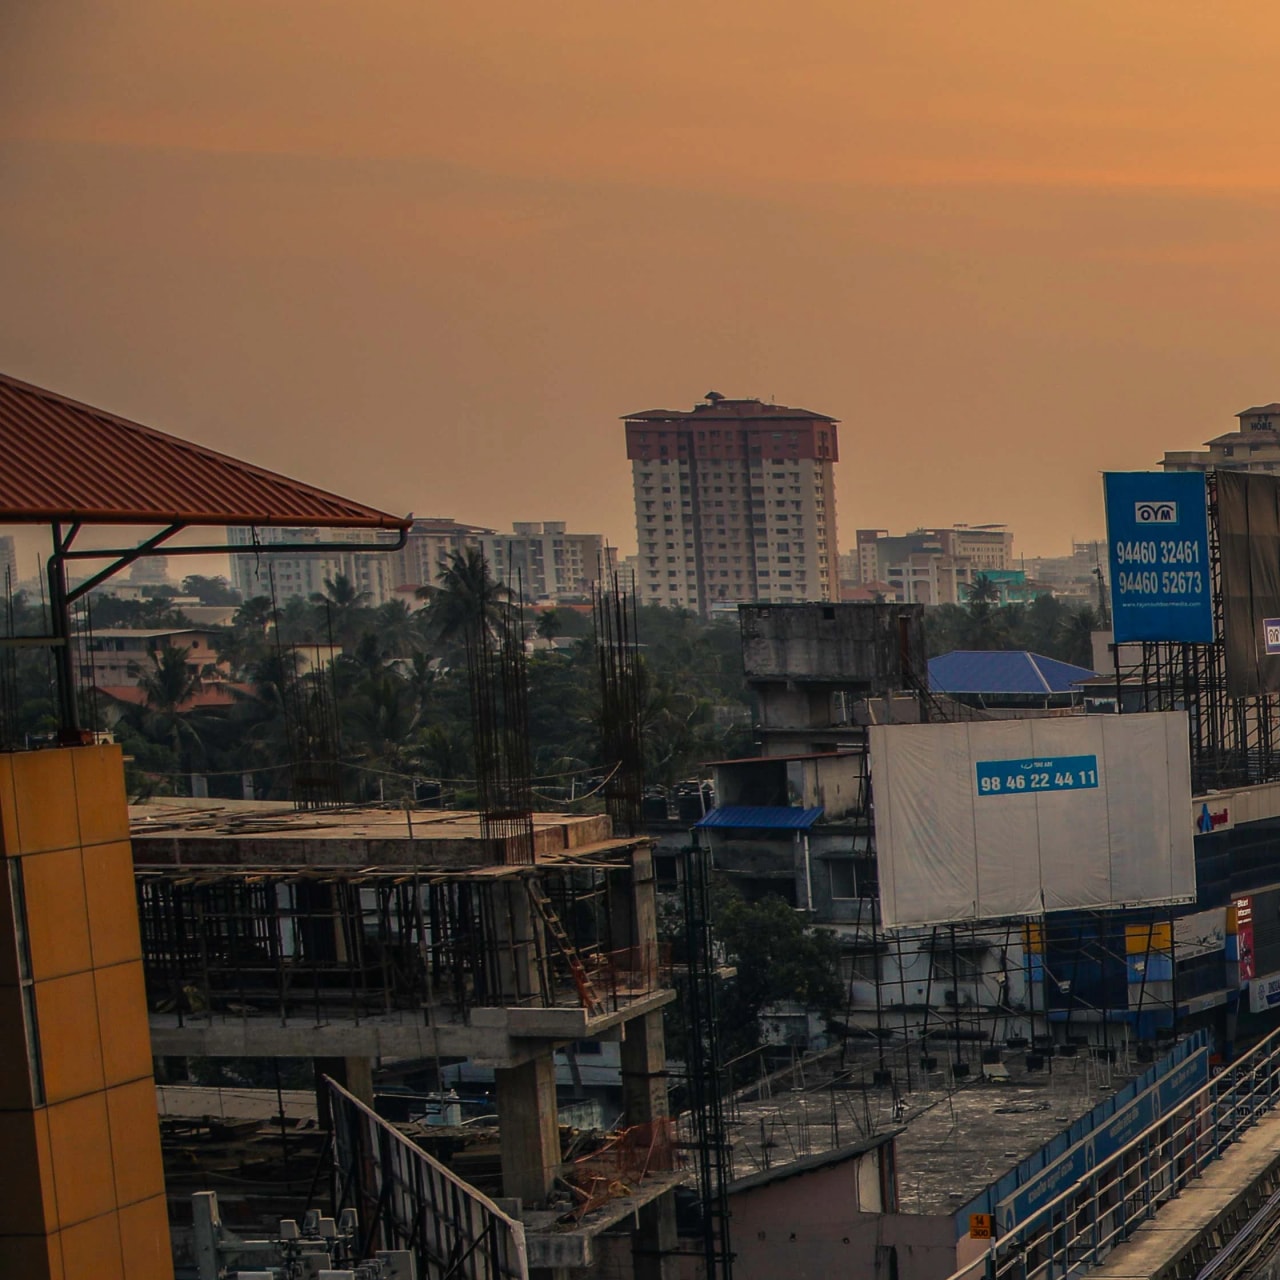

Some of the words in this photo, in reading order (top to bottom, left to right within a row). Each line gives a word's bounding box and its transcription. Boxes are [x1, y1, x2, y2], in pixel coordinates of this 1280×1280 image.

[1116, 540, 1157, 565] 94460
[1160, 540, 1200, 564] 32461
[1119, 571, 1158, 595] 94460
[1162, 571, 1202, 594] 52673
[981, 777, 1001, 791] 98
[1006, 775, 1025, 789] 46
[1030, 773, 1050, 788] 22
[1055, 772, 1074, 786] 44
[1079, 770, 1095, 785] 11
